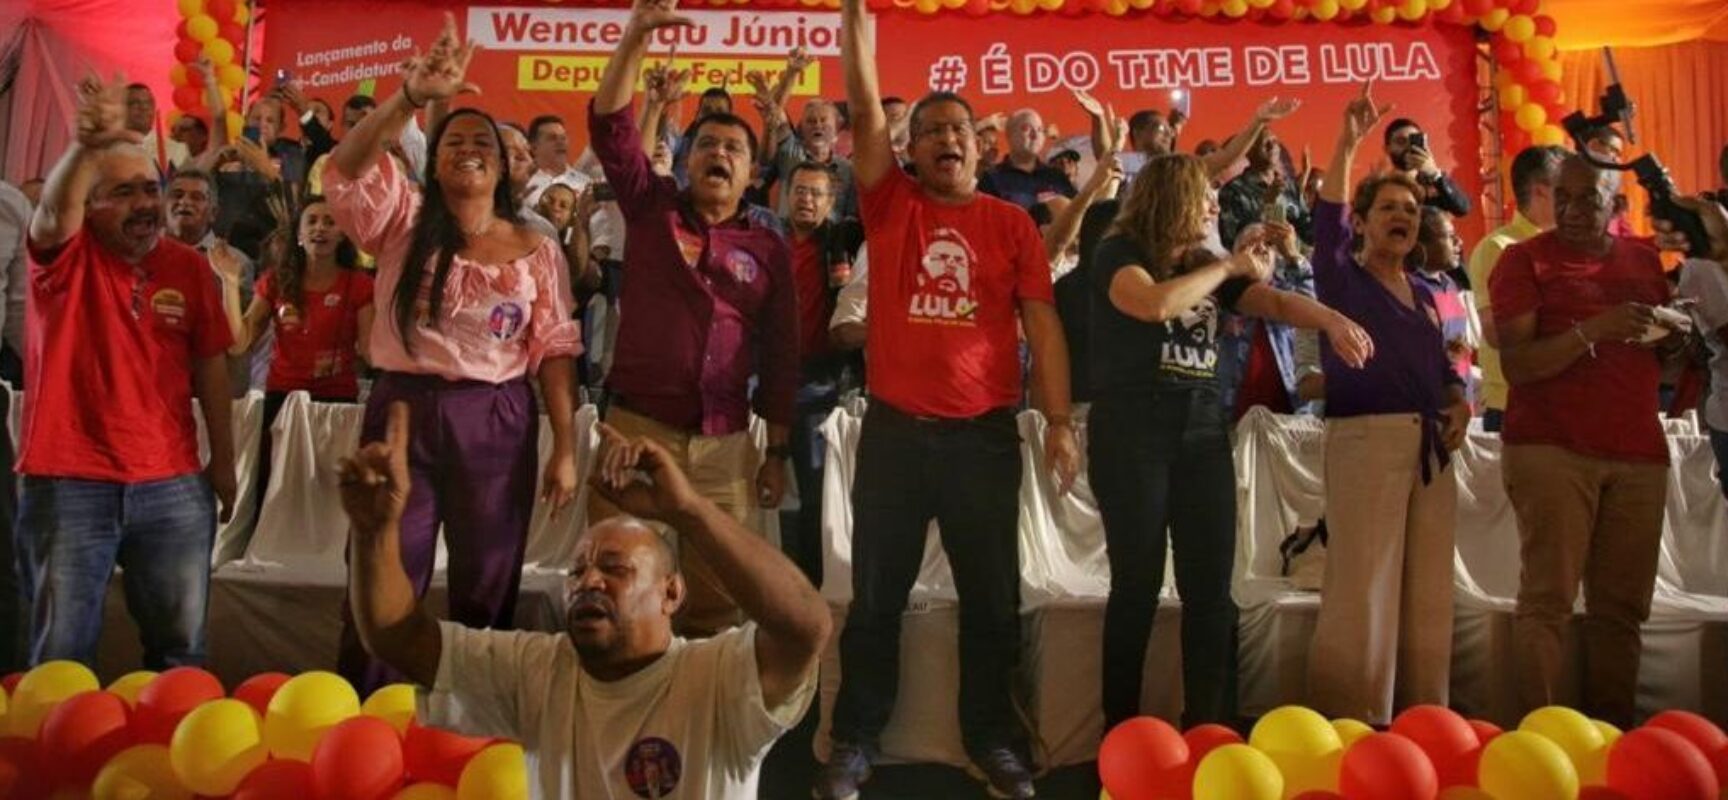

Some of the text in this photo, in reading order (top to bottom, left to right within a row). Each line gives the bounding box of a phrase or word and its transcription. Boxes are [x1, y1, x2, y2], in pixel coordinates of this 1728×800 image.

[492, 13, 707, 45] Wenceau
[296, 35, 412, 67] Lançamento da
[691, 61, 804, 86] Federl
[929, 42, 1440, 94] # É DO TIME DE LULA
[909, 293, 977, 319] LULA
[1161, 341, 1217, 371] LULA
